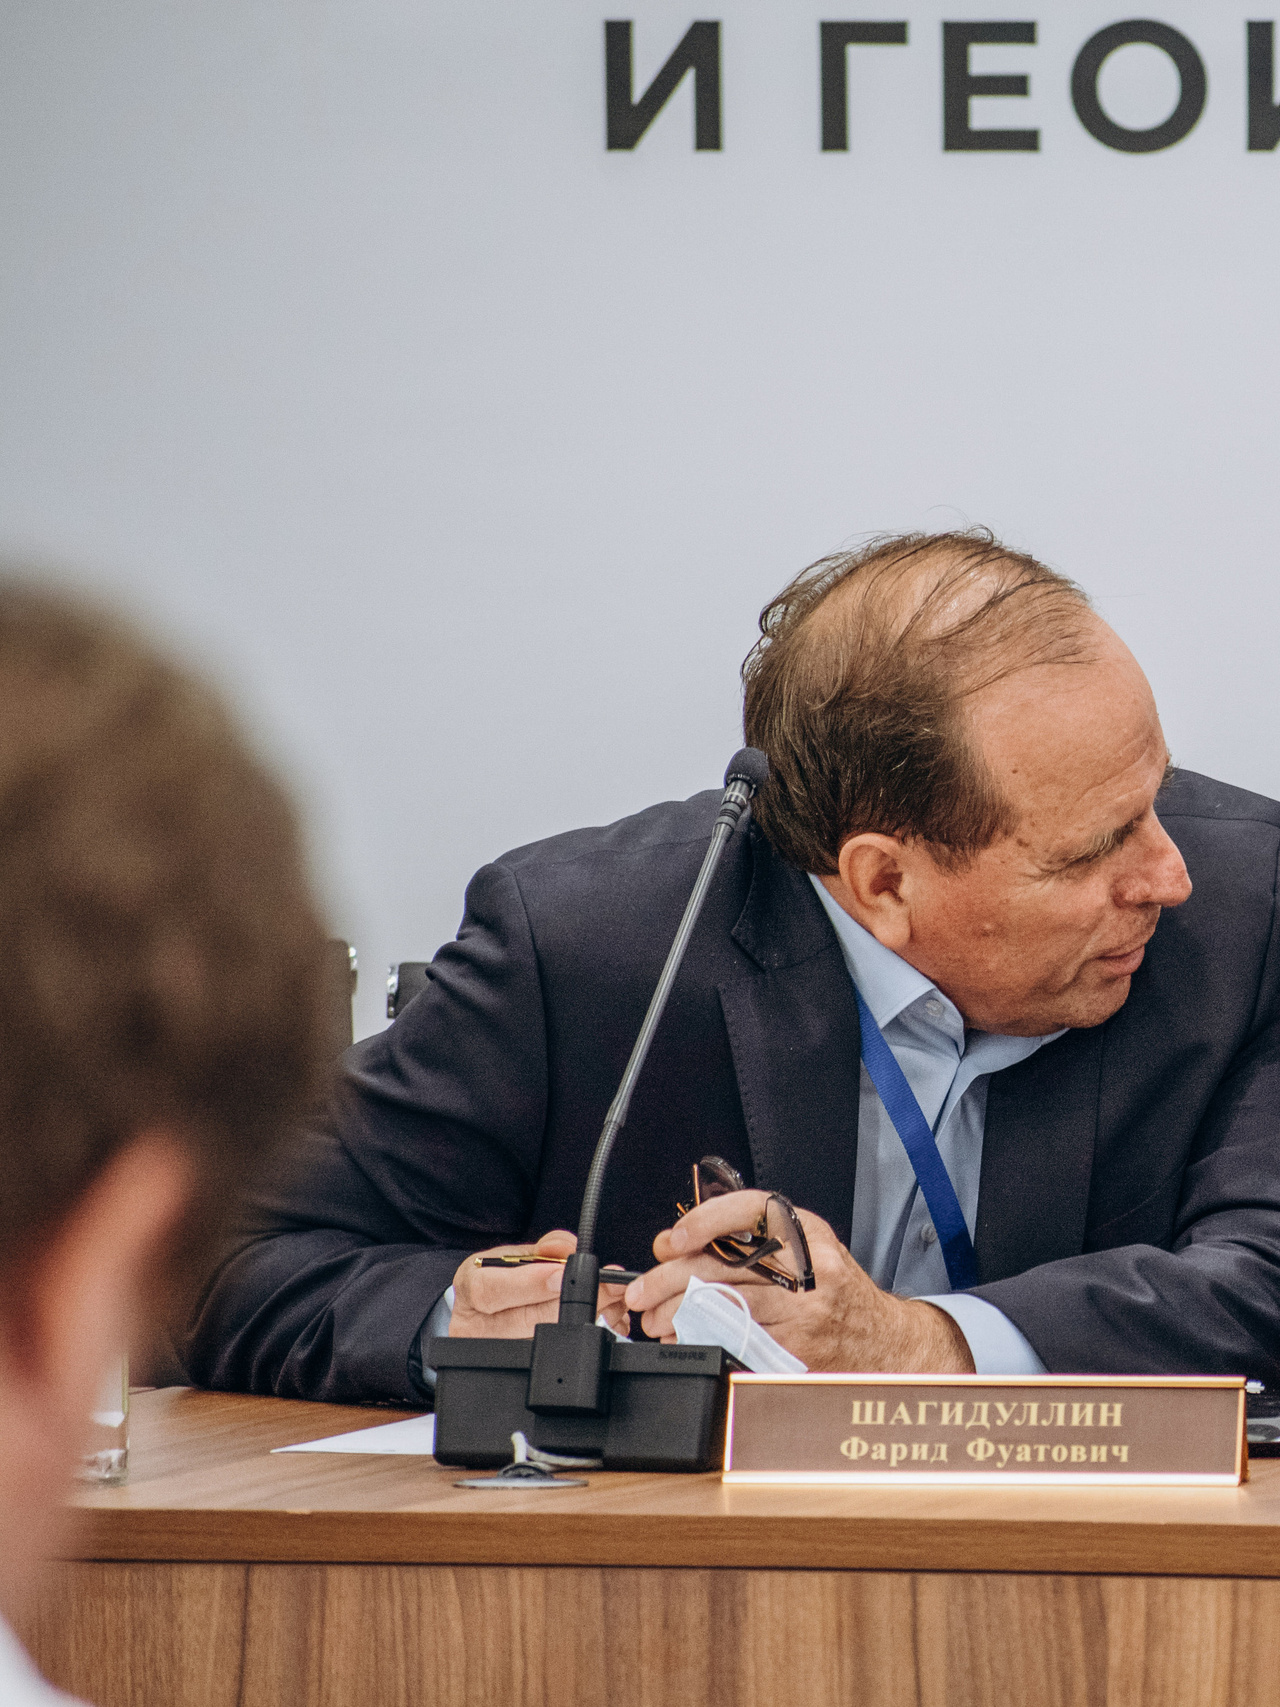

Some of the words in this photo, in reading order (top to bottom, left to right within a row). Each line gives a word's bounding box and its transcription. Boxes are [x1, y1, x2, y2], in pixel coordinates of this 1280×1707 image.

[604, 19, 722, 152] И
[850, 1400, 1124, 1430] ШАГИДУЛЛИН
[839, 1436, 948, 1467] Фарид
[965, 1437, 1130, 1468] Фуатович
